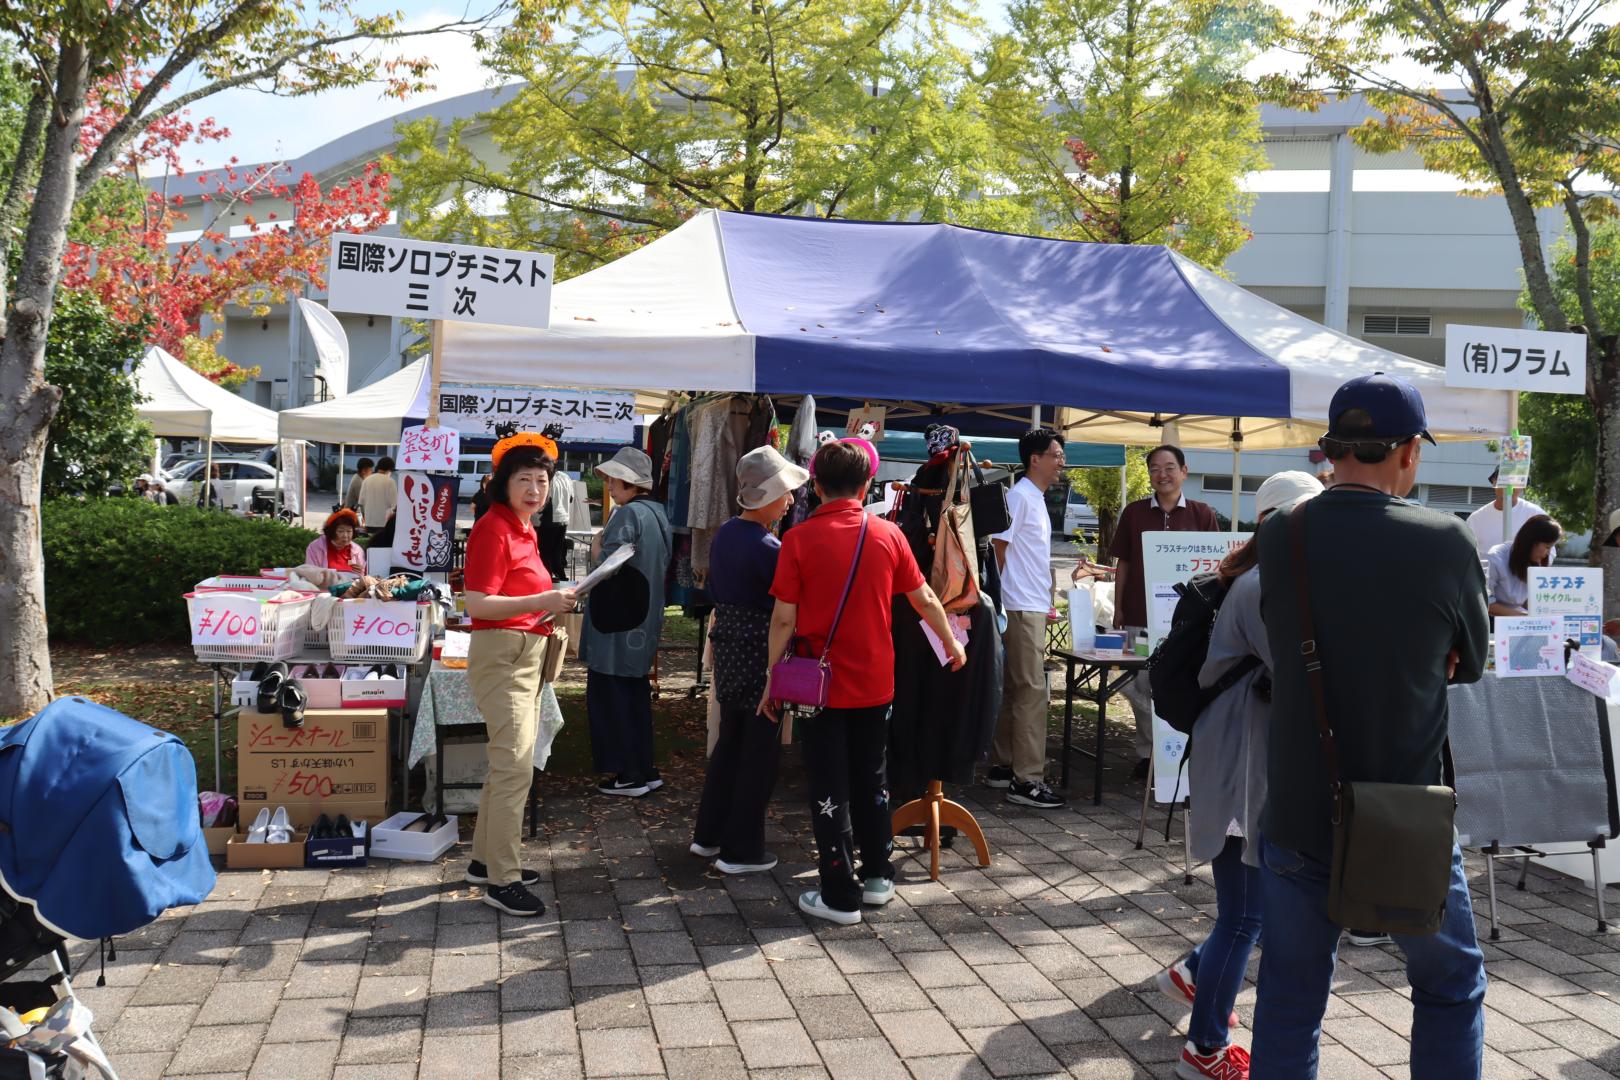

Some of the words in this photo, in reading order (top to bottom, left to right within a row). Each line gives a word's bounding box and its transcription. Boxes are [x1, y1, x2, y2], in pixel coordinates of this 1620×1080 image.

[337, 240, 547, 288] 国際ソロプチミスト
[406, 282, 477, 316] 三次
[1462, 341, 1571, 377] (有)フラム
[439, 392, 634, 421] 国際ソロプチミスト三次
[402, 431, 454, 456] 宝さがし
[436, 488, 450, 520] ようこそ
[401, 475, 430, 566] いらっしゃいませ
[1155, 544, 1225, 554] プラスチックはきちんと
[1175, 564, 1188, 572] また
[1535, 593, 1571, 603] リサイクル
[198, 608, 257, 636] ¥100
[271, 759, 286, 768] LS
[290, 758, 354, 769] いか味天かす
[272, 770, 333, 798] ¥500
